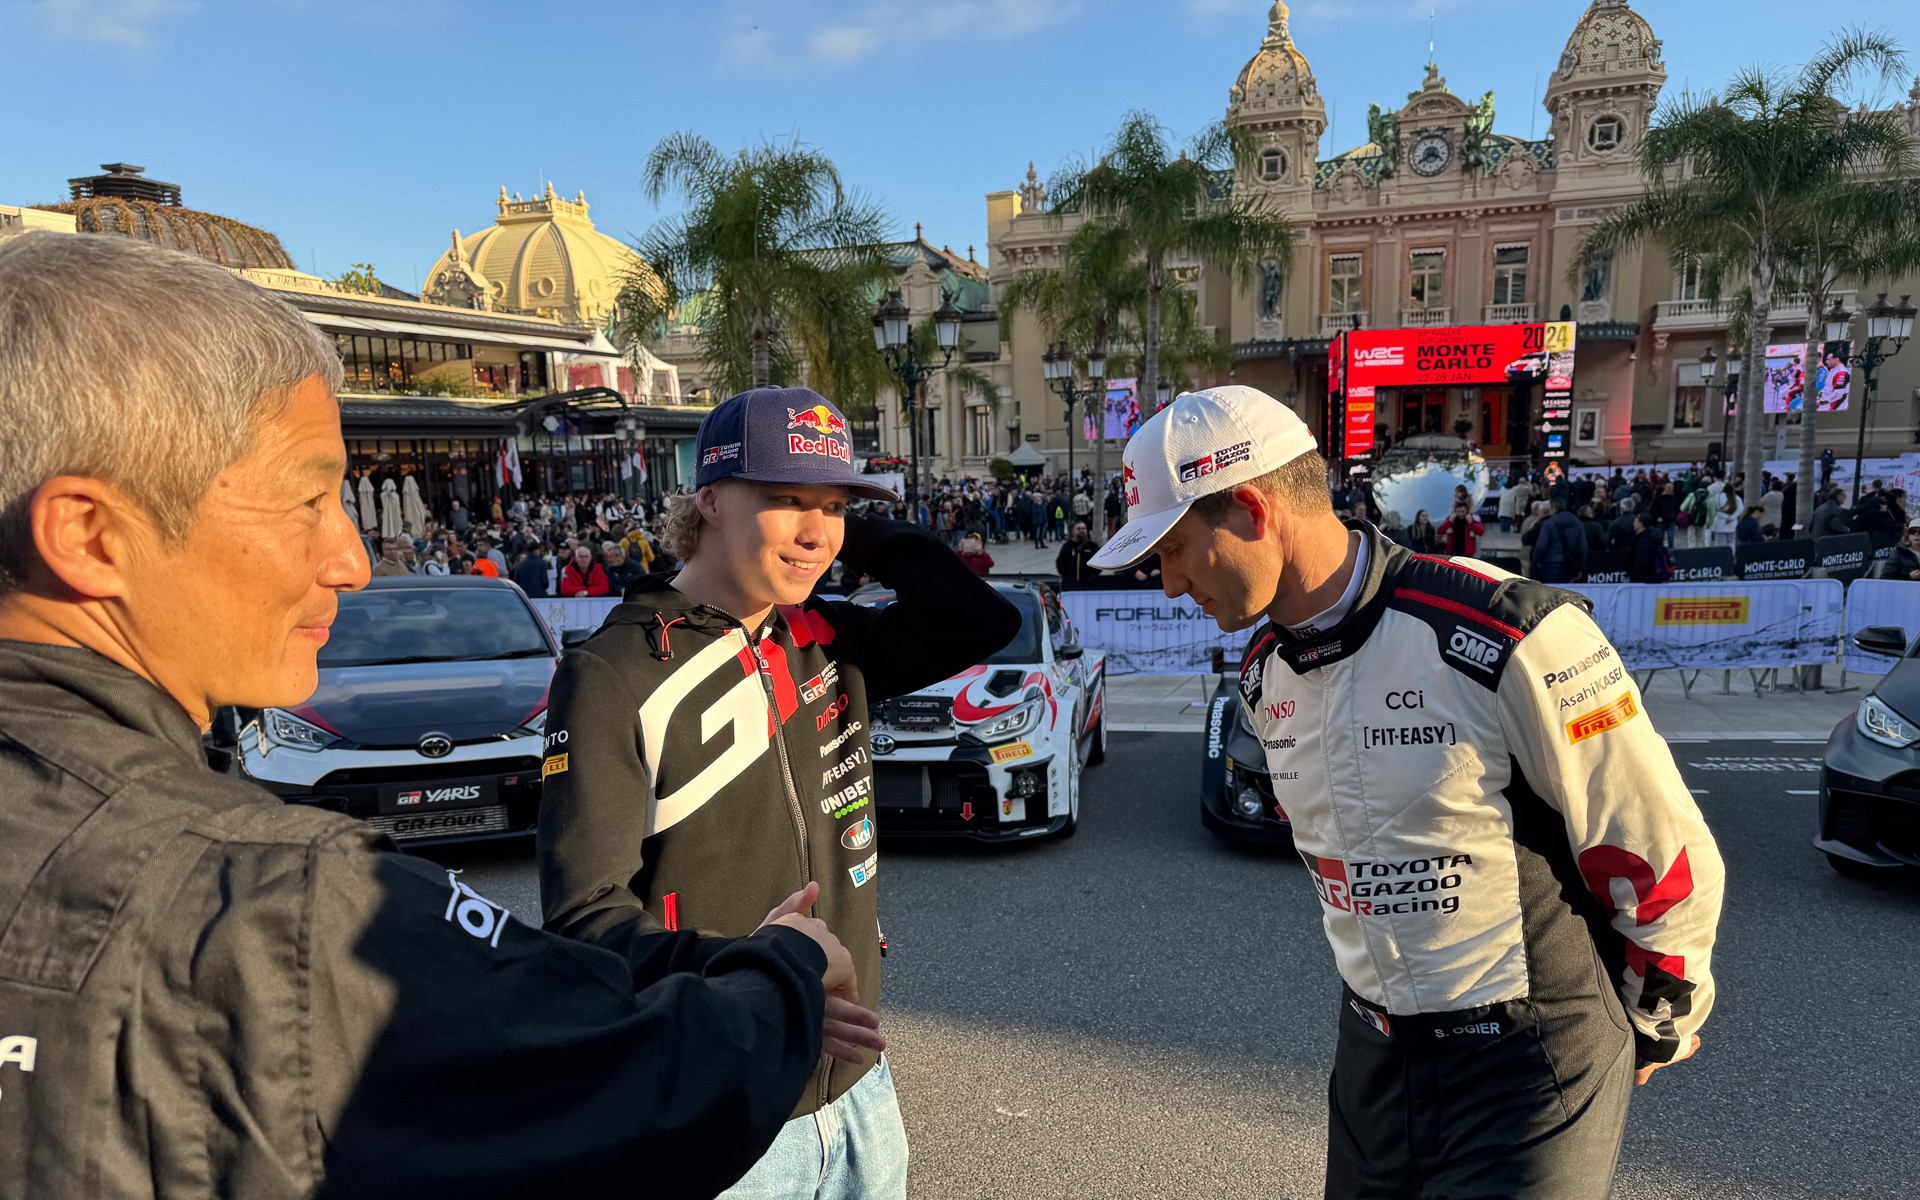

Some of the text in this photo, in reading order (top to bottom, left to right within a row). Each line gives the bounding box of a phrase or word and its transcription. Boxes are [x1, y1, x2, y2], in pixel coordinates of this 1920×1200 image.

[1417, 336, 1471, 344] AUTOMOBILE
[1432, 328, 1462, 336] RALLYE
[1523, 325, 1568, 349] 2024
[1354, 346, 1405, 360] WRC
[1417, 343, 1496, 358] MONTE
[1416, 357, 1492, 371] CARLO
[1417, 372, 1472, 382] 22-28 JAN
[789, 434, 851, 465] Red Bull
[1214, 440, 1252, 458] TOYOTA
[1215, 447, 1250, 464] GAZOO
[1180, 460, 1213, 483] GR
[1216, 454, 1250, 471] Racing
[1663, 601, 1742, 621] PIRELLI
[1449, 632, 1499, 667] OMP
[1542, 644, 1611, 689] Panasonic
[802, 682, 825, 702] GR
[1385, 689, 1424, 710] CCi
[1208, 696, 1230, 759] Panasonic
[1571, 697, 1635, 740] PIRELLI
[993, 743, 1031, 760] PIRELLI
[1279, 771, 1299, 780] MILLE
[397, 793, 421, 805] GR
[820, 775, 871, 814] UNIBET
[1349, 854, 1473, 879] TOYOTA
[1351, 873, 1462, 897] GAZOO
[1353, 895, 1460, 916] Racing
[1434, 1022, 1500, 1038] S. OGIER
